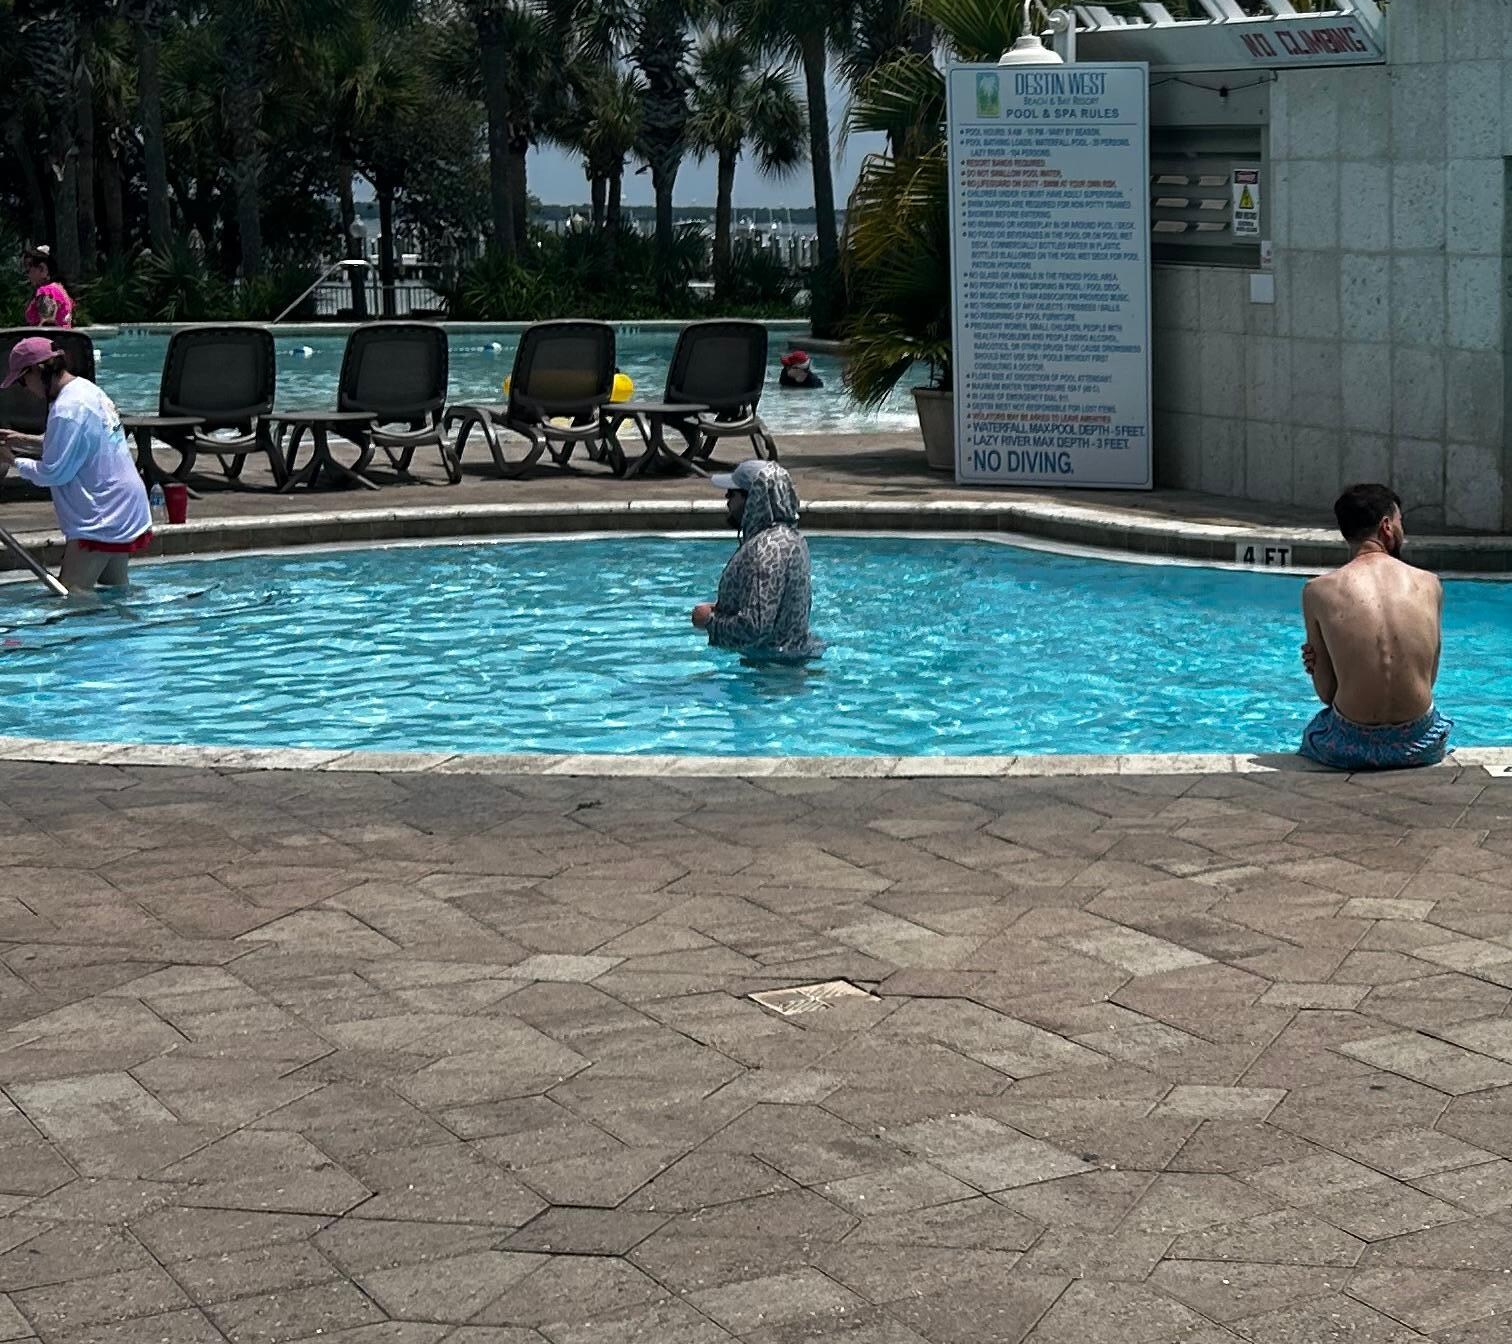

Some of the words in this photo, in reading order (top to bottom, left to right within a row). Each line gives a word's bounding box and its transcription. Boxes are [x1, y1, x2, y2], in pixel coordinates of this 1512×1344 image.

[1240, 33, 1278, 57] NO
[1274, 27, 1368, 56] CLIMBING
[1015, 72, 1064, 95] DESTIN
[1068, 72, 1107, 95] WEST
[1073, 97, 1099, 105] RESORT
[1006, 108, 1039, 119] POOL
[1042, 109, 1050, 119] &
[1054, 109, 1076, 119] SPA
[1081, 109, 1119, 119] RULES
[973, 422, 1028, 433] WATERFALL
[1051, 424, 1077, 435] POOL
[1079, 425, 1110, 435] DEPTH
[973, 435, 999, 446] LAZY
[1000, 436, 1031, 447] RIVER
[1033, 437, 1054, 447] MAX
[1057, 437, 1089, 448] DEPTH
[1097, 438, 1102, 448] 3
[974, 450, 1001, 472] NO
[1007, 450, 1074, 474] DIVING.
[1243, 546, 1255, 564] 4
[1265, 547, 1289, 567] FT
